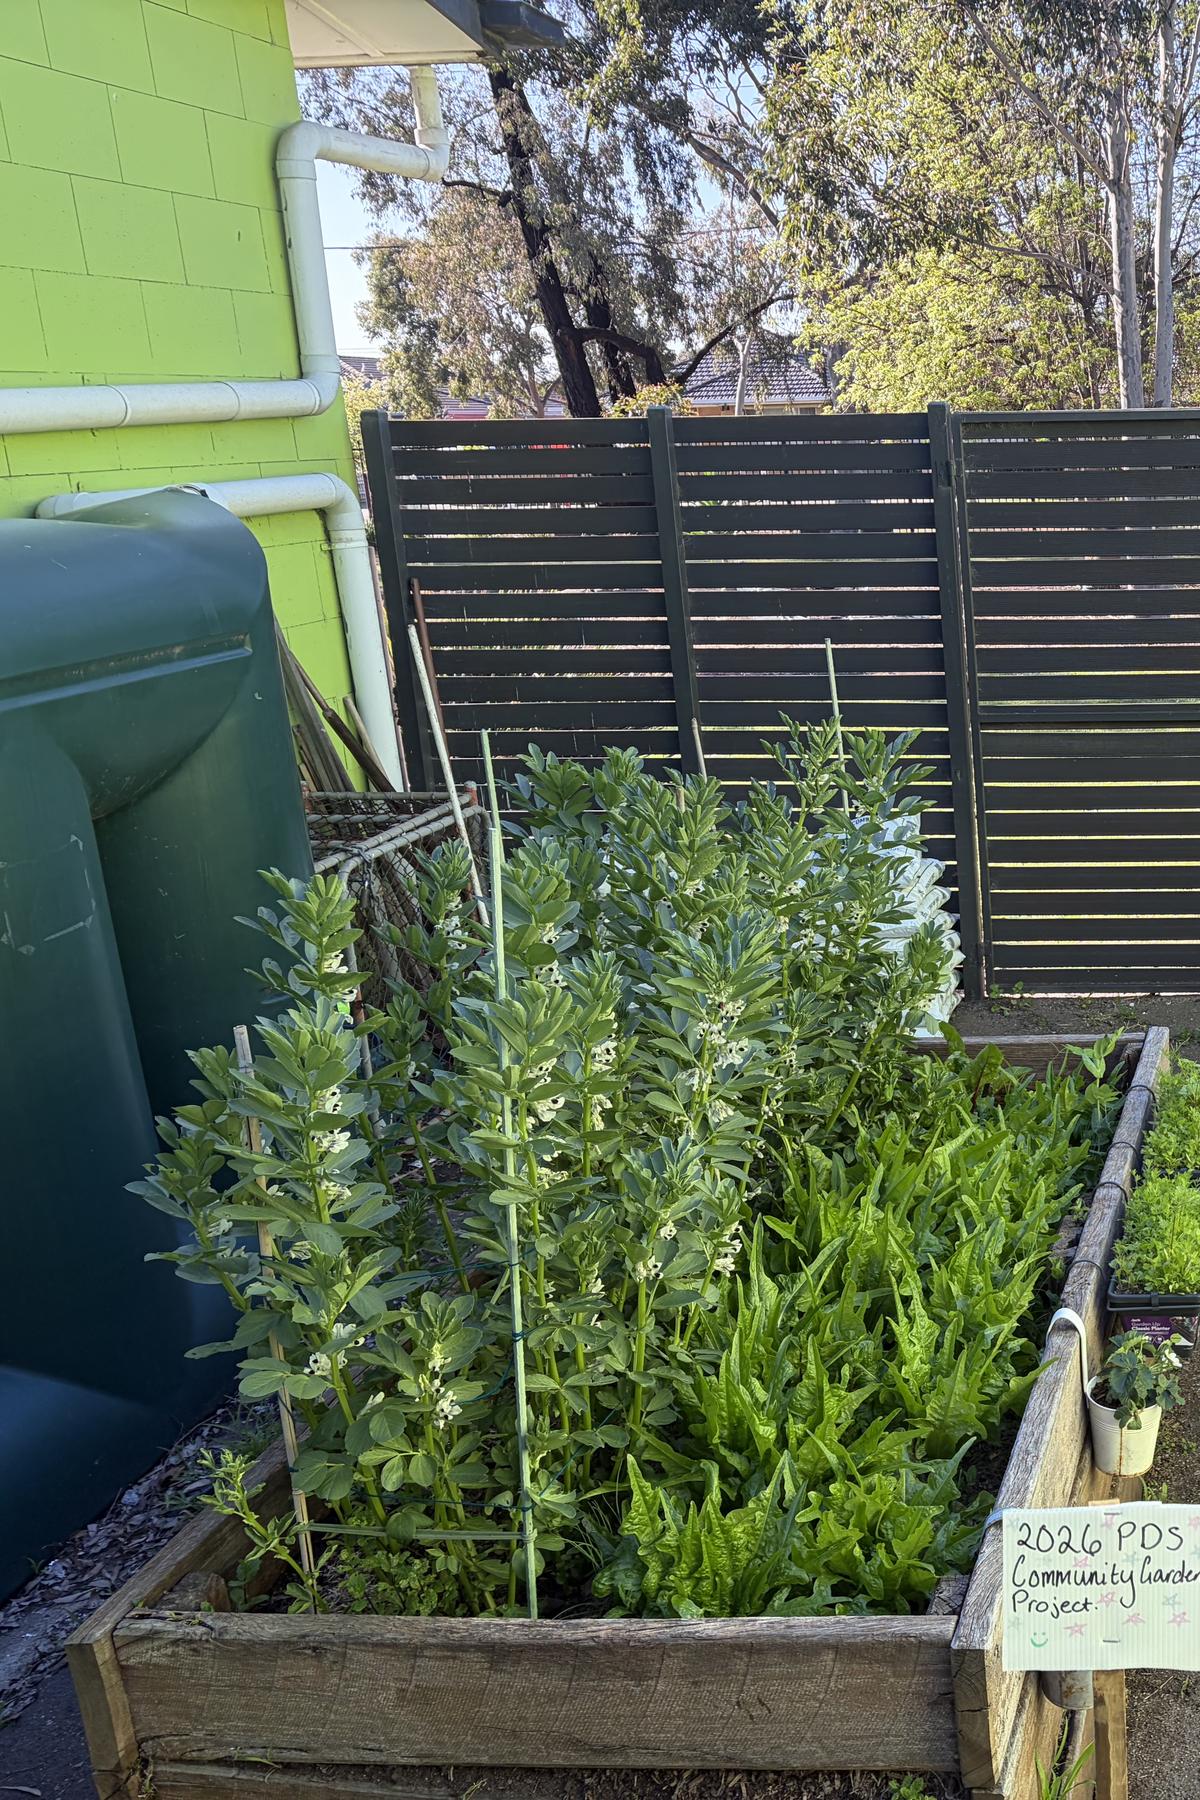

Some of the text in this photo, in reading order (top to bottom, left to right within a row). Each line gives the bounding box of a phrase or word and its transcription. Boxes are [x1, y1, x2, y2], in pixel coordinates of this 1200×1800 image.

[1017, 1521, 1184, 1556] 2026 PDS
[1012, 1554, 1136, 1609] Community
